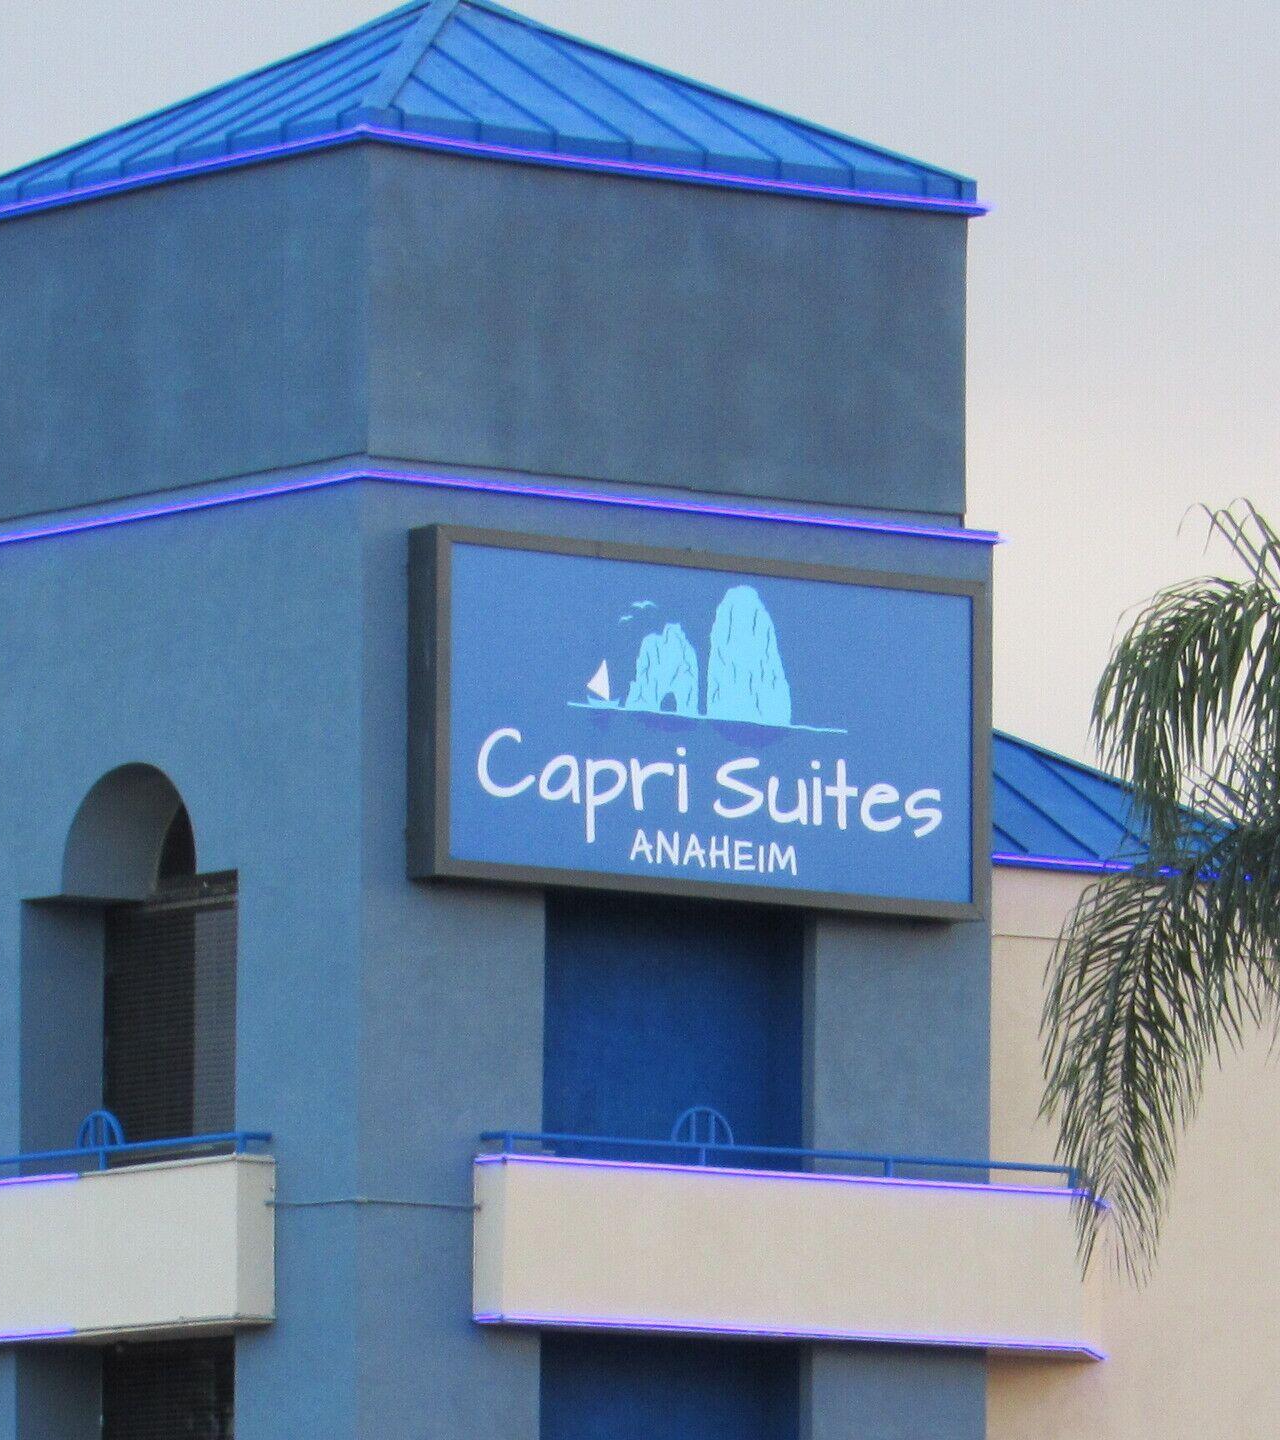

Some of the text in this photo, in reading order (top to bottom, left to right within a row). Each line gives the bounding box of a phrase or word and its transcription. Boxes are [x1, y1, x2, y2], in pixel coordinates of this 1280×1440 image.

[477, 727, 942, 844] Capri Suites
[629, 828, 797, 876] ANAHEIM
